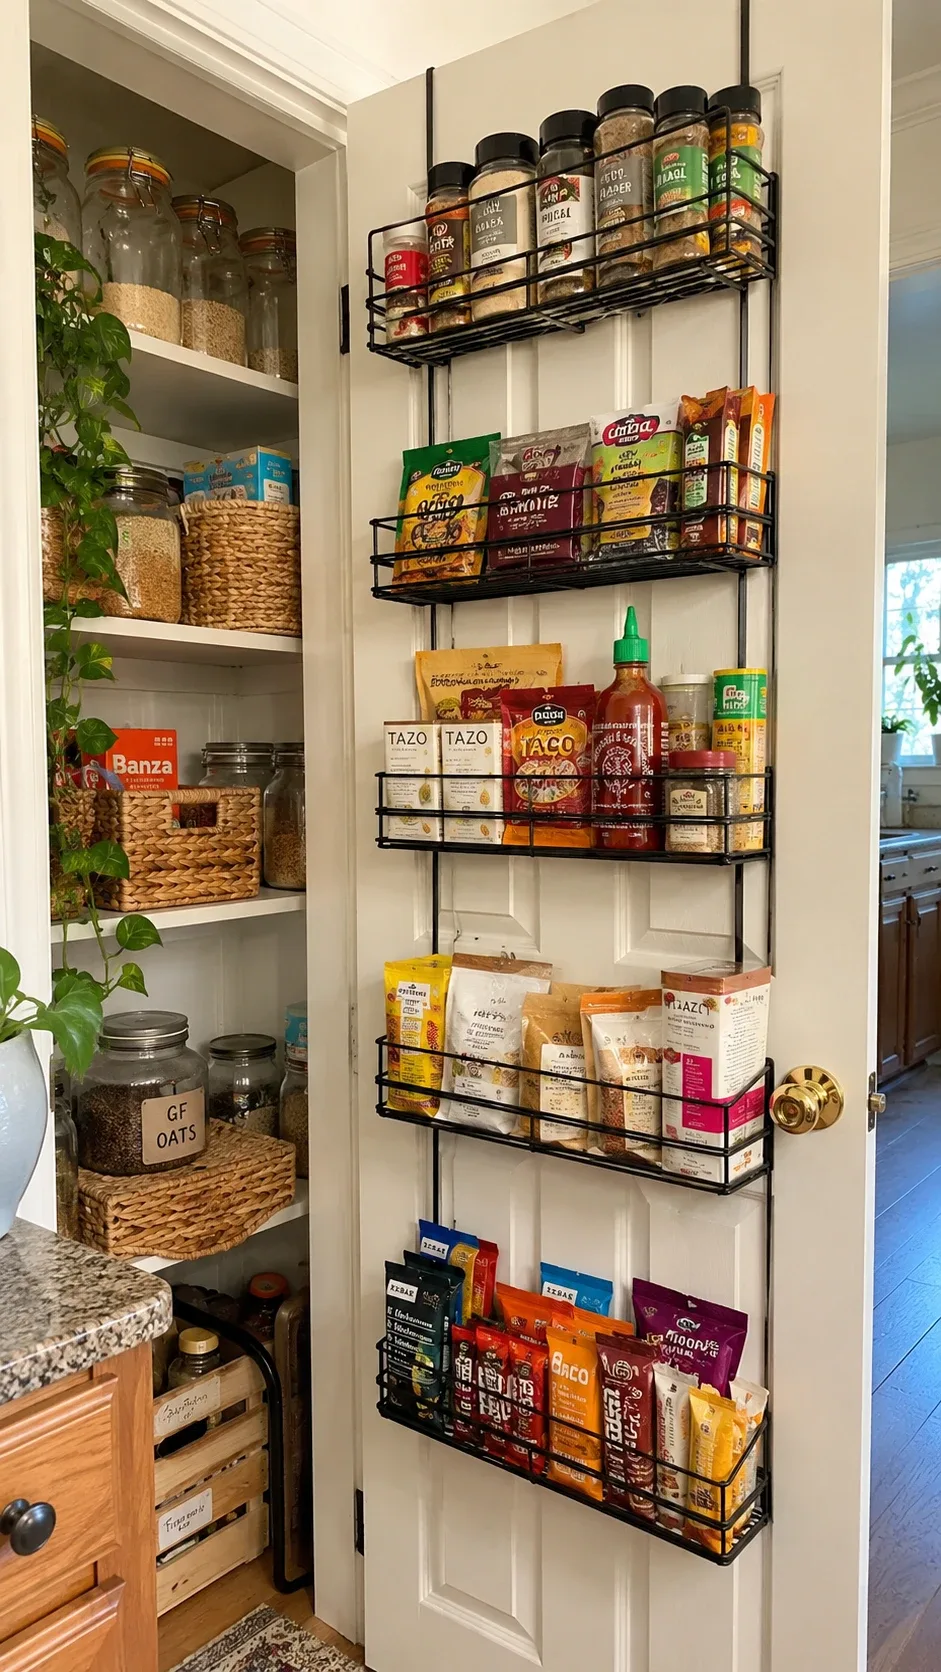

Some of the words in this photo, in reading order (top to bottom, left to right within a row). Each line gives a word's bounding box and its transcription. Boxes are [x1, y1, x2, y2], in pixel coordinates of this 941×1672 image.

[388, 731, 427, 745] TAZO
[445, 730, 488, 745] TAZO
[520, 734, 575, 757] TACO
[112, 754, 173, 775] Banza
[167, 1101, 187, 1122] GF
[157, 1124, 196, 1149] OATS
